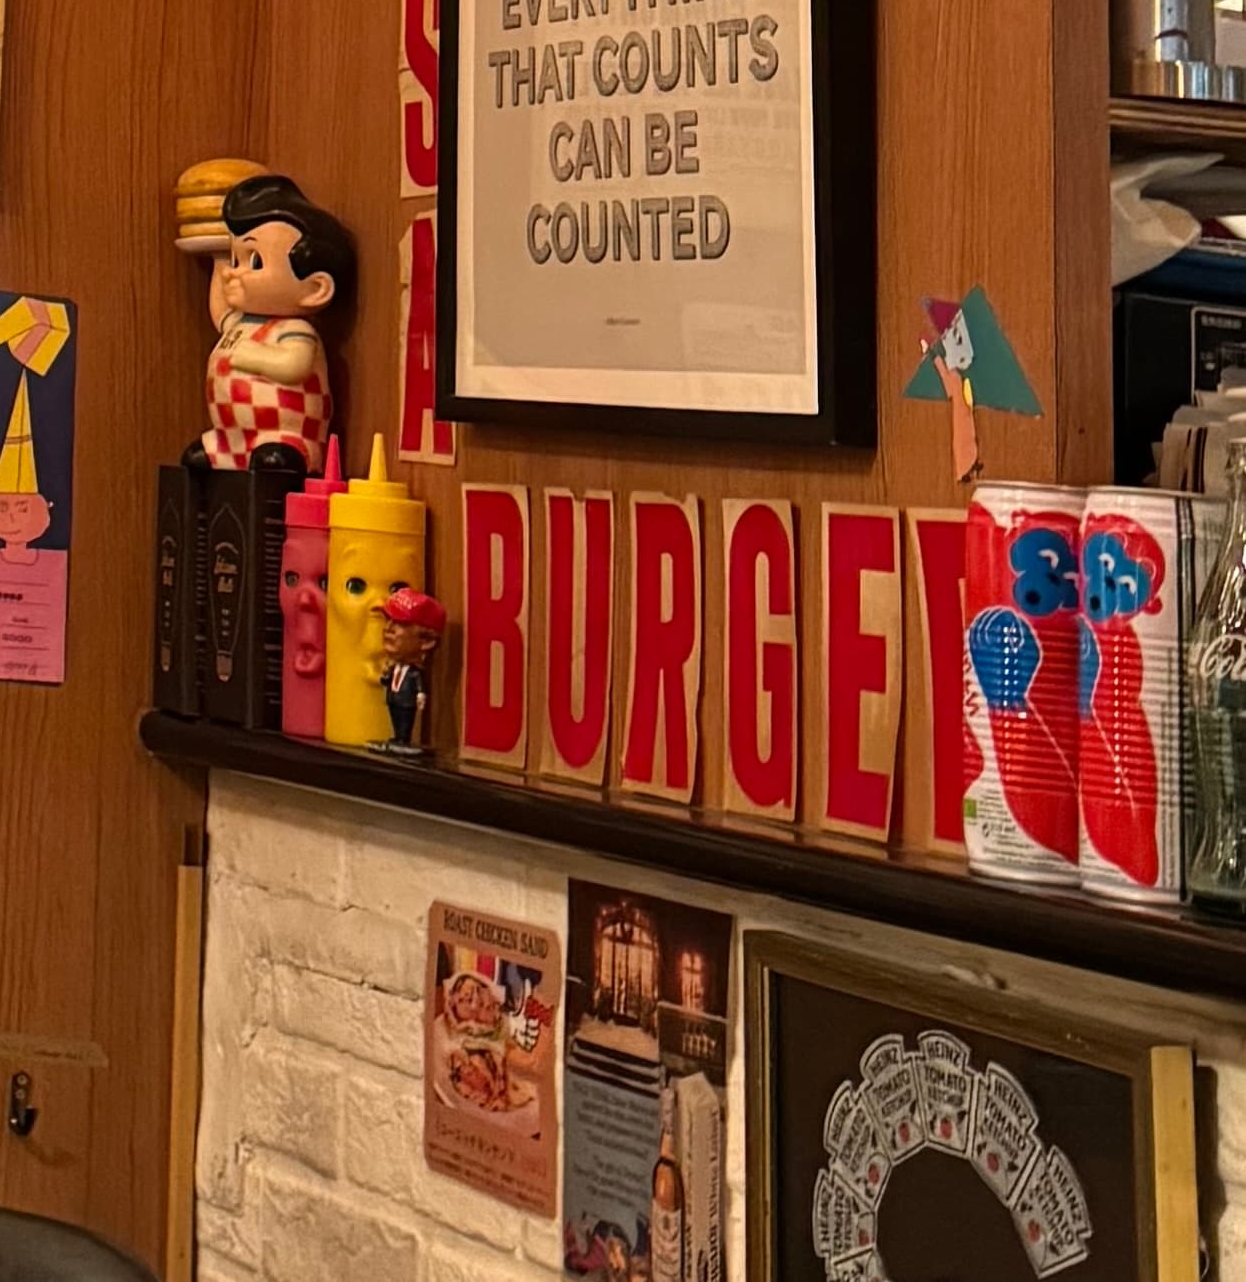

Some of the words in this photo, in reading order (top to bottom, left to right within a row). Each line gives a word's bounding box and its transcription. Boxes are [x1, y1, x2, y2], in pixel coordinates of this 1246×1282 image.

[488, 38, 583, 109] THAT
[592, 14, 780, 98] COUNTS
[548, 115, 631, 183] CAN
[645, 109, 700, 177] BE
[526, 194, 731, 264] COUNTED
[475, 919, 519, 950] CHICKEN
[520, 932, 550, 960] SAND
[924, 1064, 967, 1093] TOMATO
[927, 1041, 960, 1069] HEINZ
[986, 1097, 1027, 1152] TOMATO
[994, 1078, 1027, 1127] HEINZ
[1041, 1170, 1075, 1246] TOMATO
[1053, 1165, 1082, 1223] HEINZ
